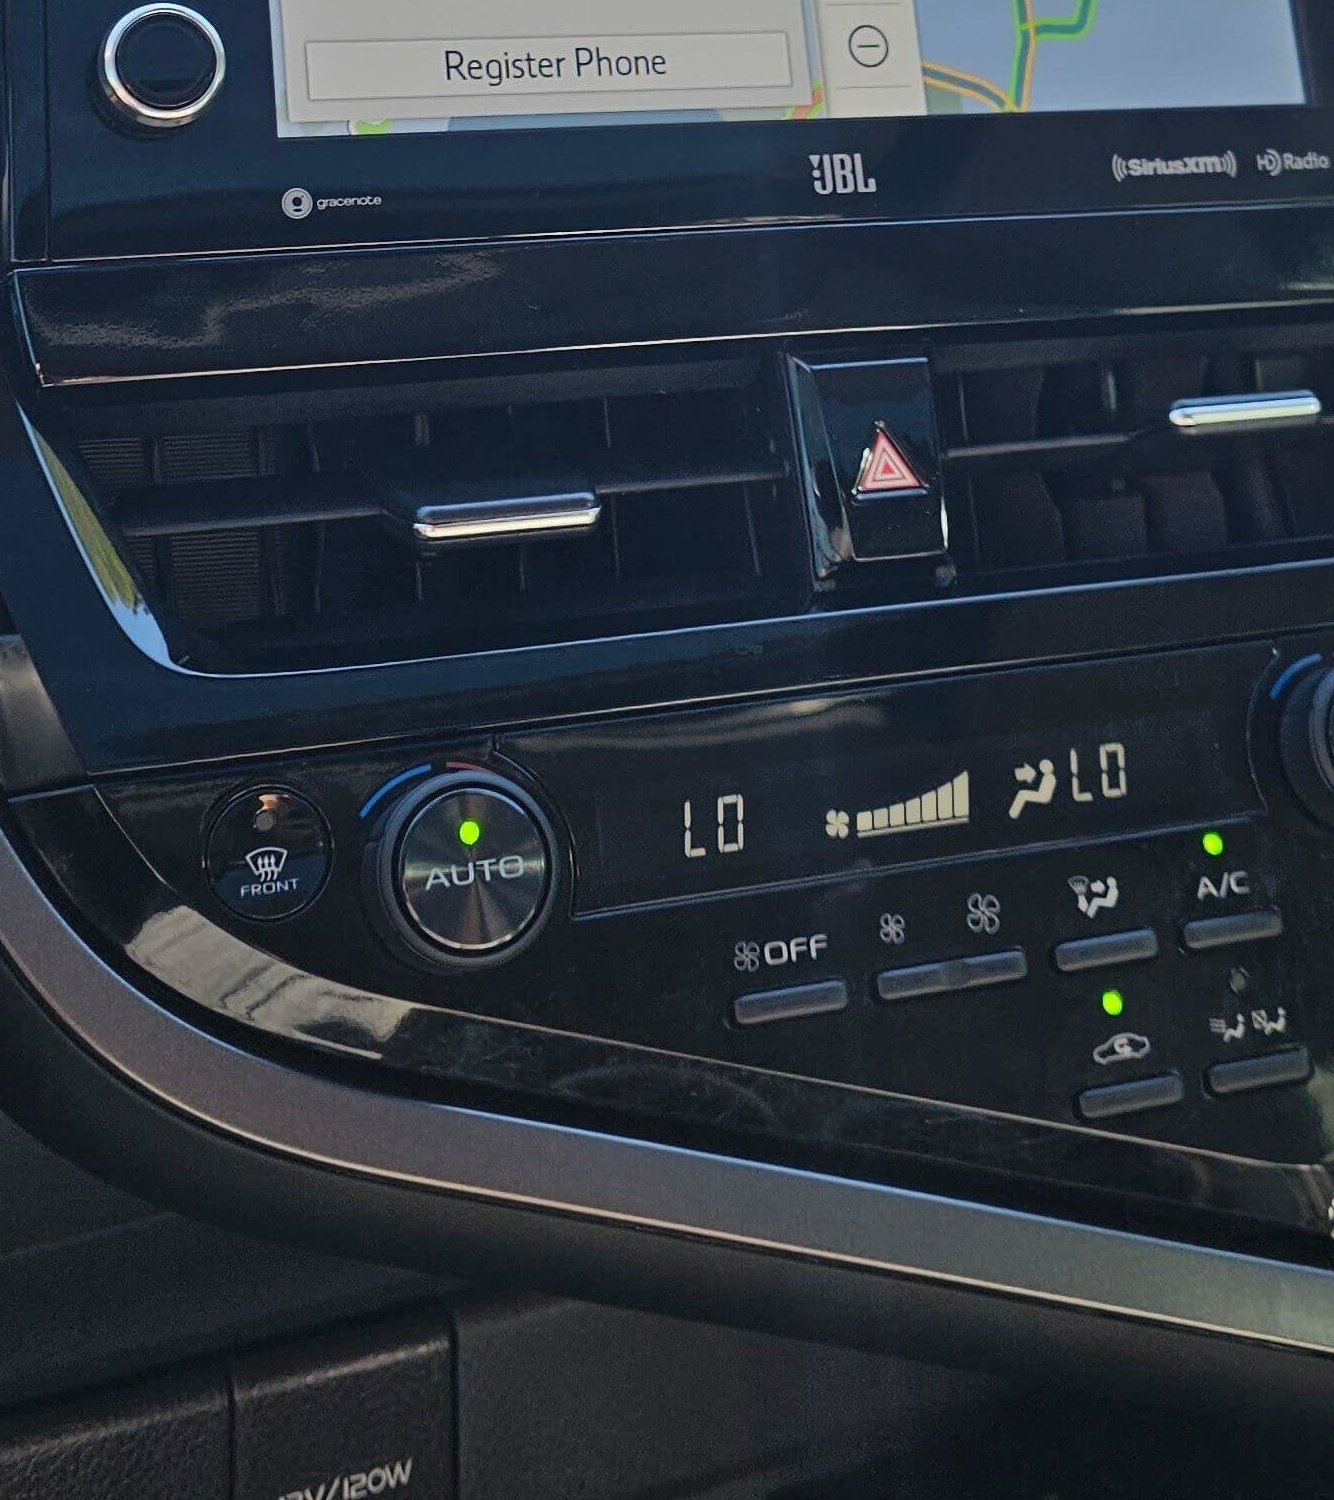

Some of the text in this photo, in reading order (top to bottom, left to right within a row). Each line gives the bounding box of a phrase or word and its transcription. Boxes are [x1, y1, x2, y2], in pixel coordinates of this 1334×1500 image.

[444, 47, 667, 87] Register Phone
[811, 154, 876, 194] JBL
[1283, 151, 1331, 170] Radio
[316, 195, 382, 210] gracenote
[240, 877, 299, 899] FRONT
[425, 854, 525, 891] AUTO
[1196, 868, 1251, 900] A/C
[764, 933, 829, 967] OFF
